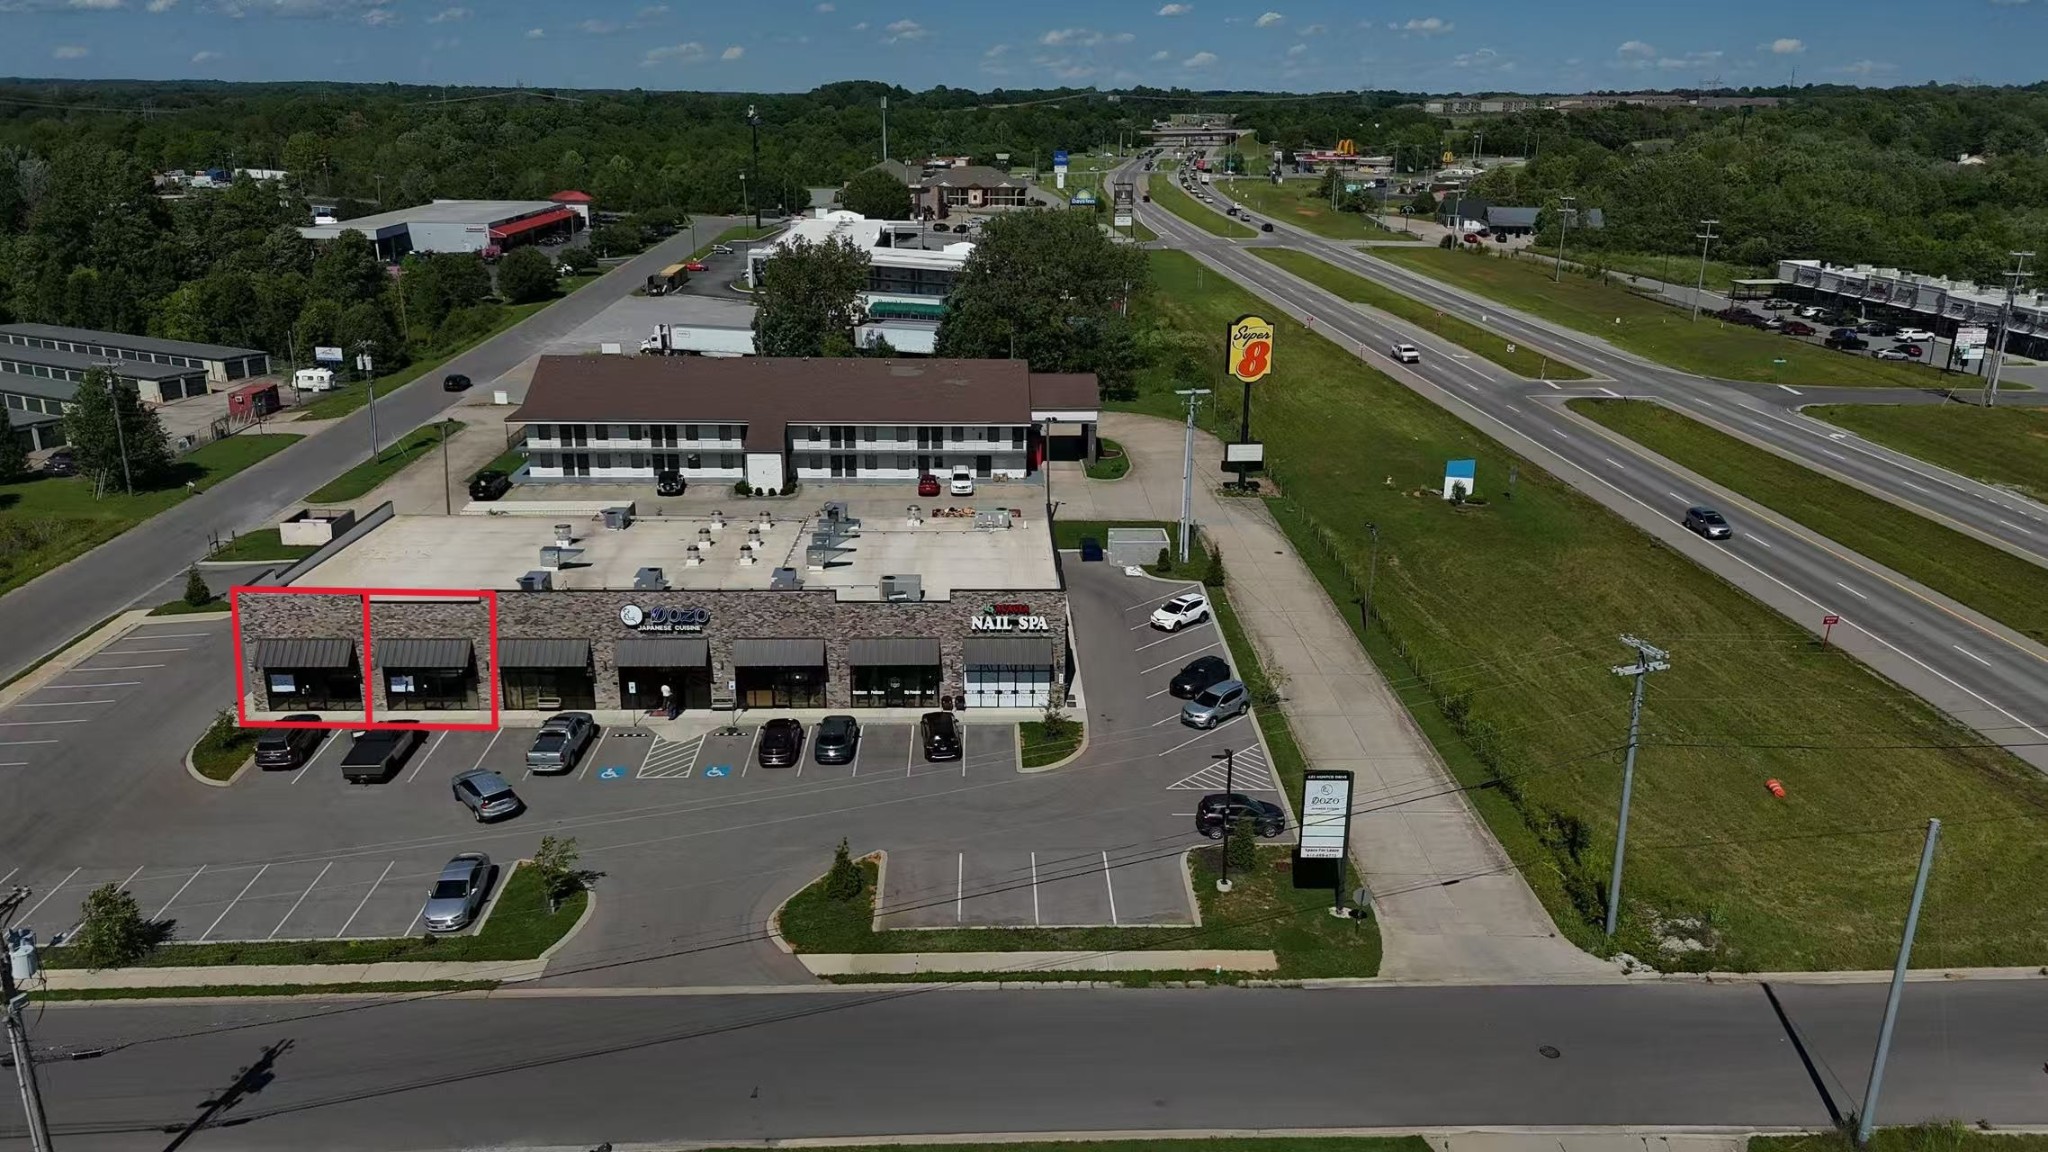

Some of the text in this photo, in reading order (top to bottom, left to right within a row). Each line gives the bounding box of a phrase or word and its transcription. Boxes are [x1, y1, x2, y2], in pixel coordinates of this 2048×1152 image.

[1233, 325, 1271, 348] Super
[1236, 341, 1270, 378] 8
[971, 615, 1049, 630] NAIL SPA
